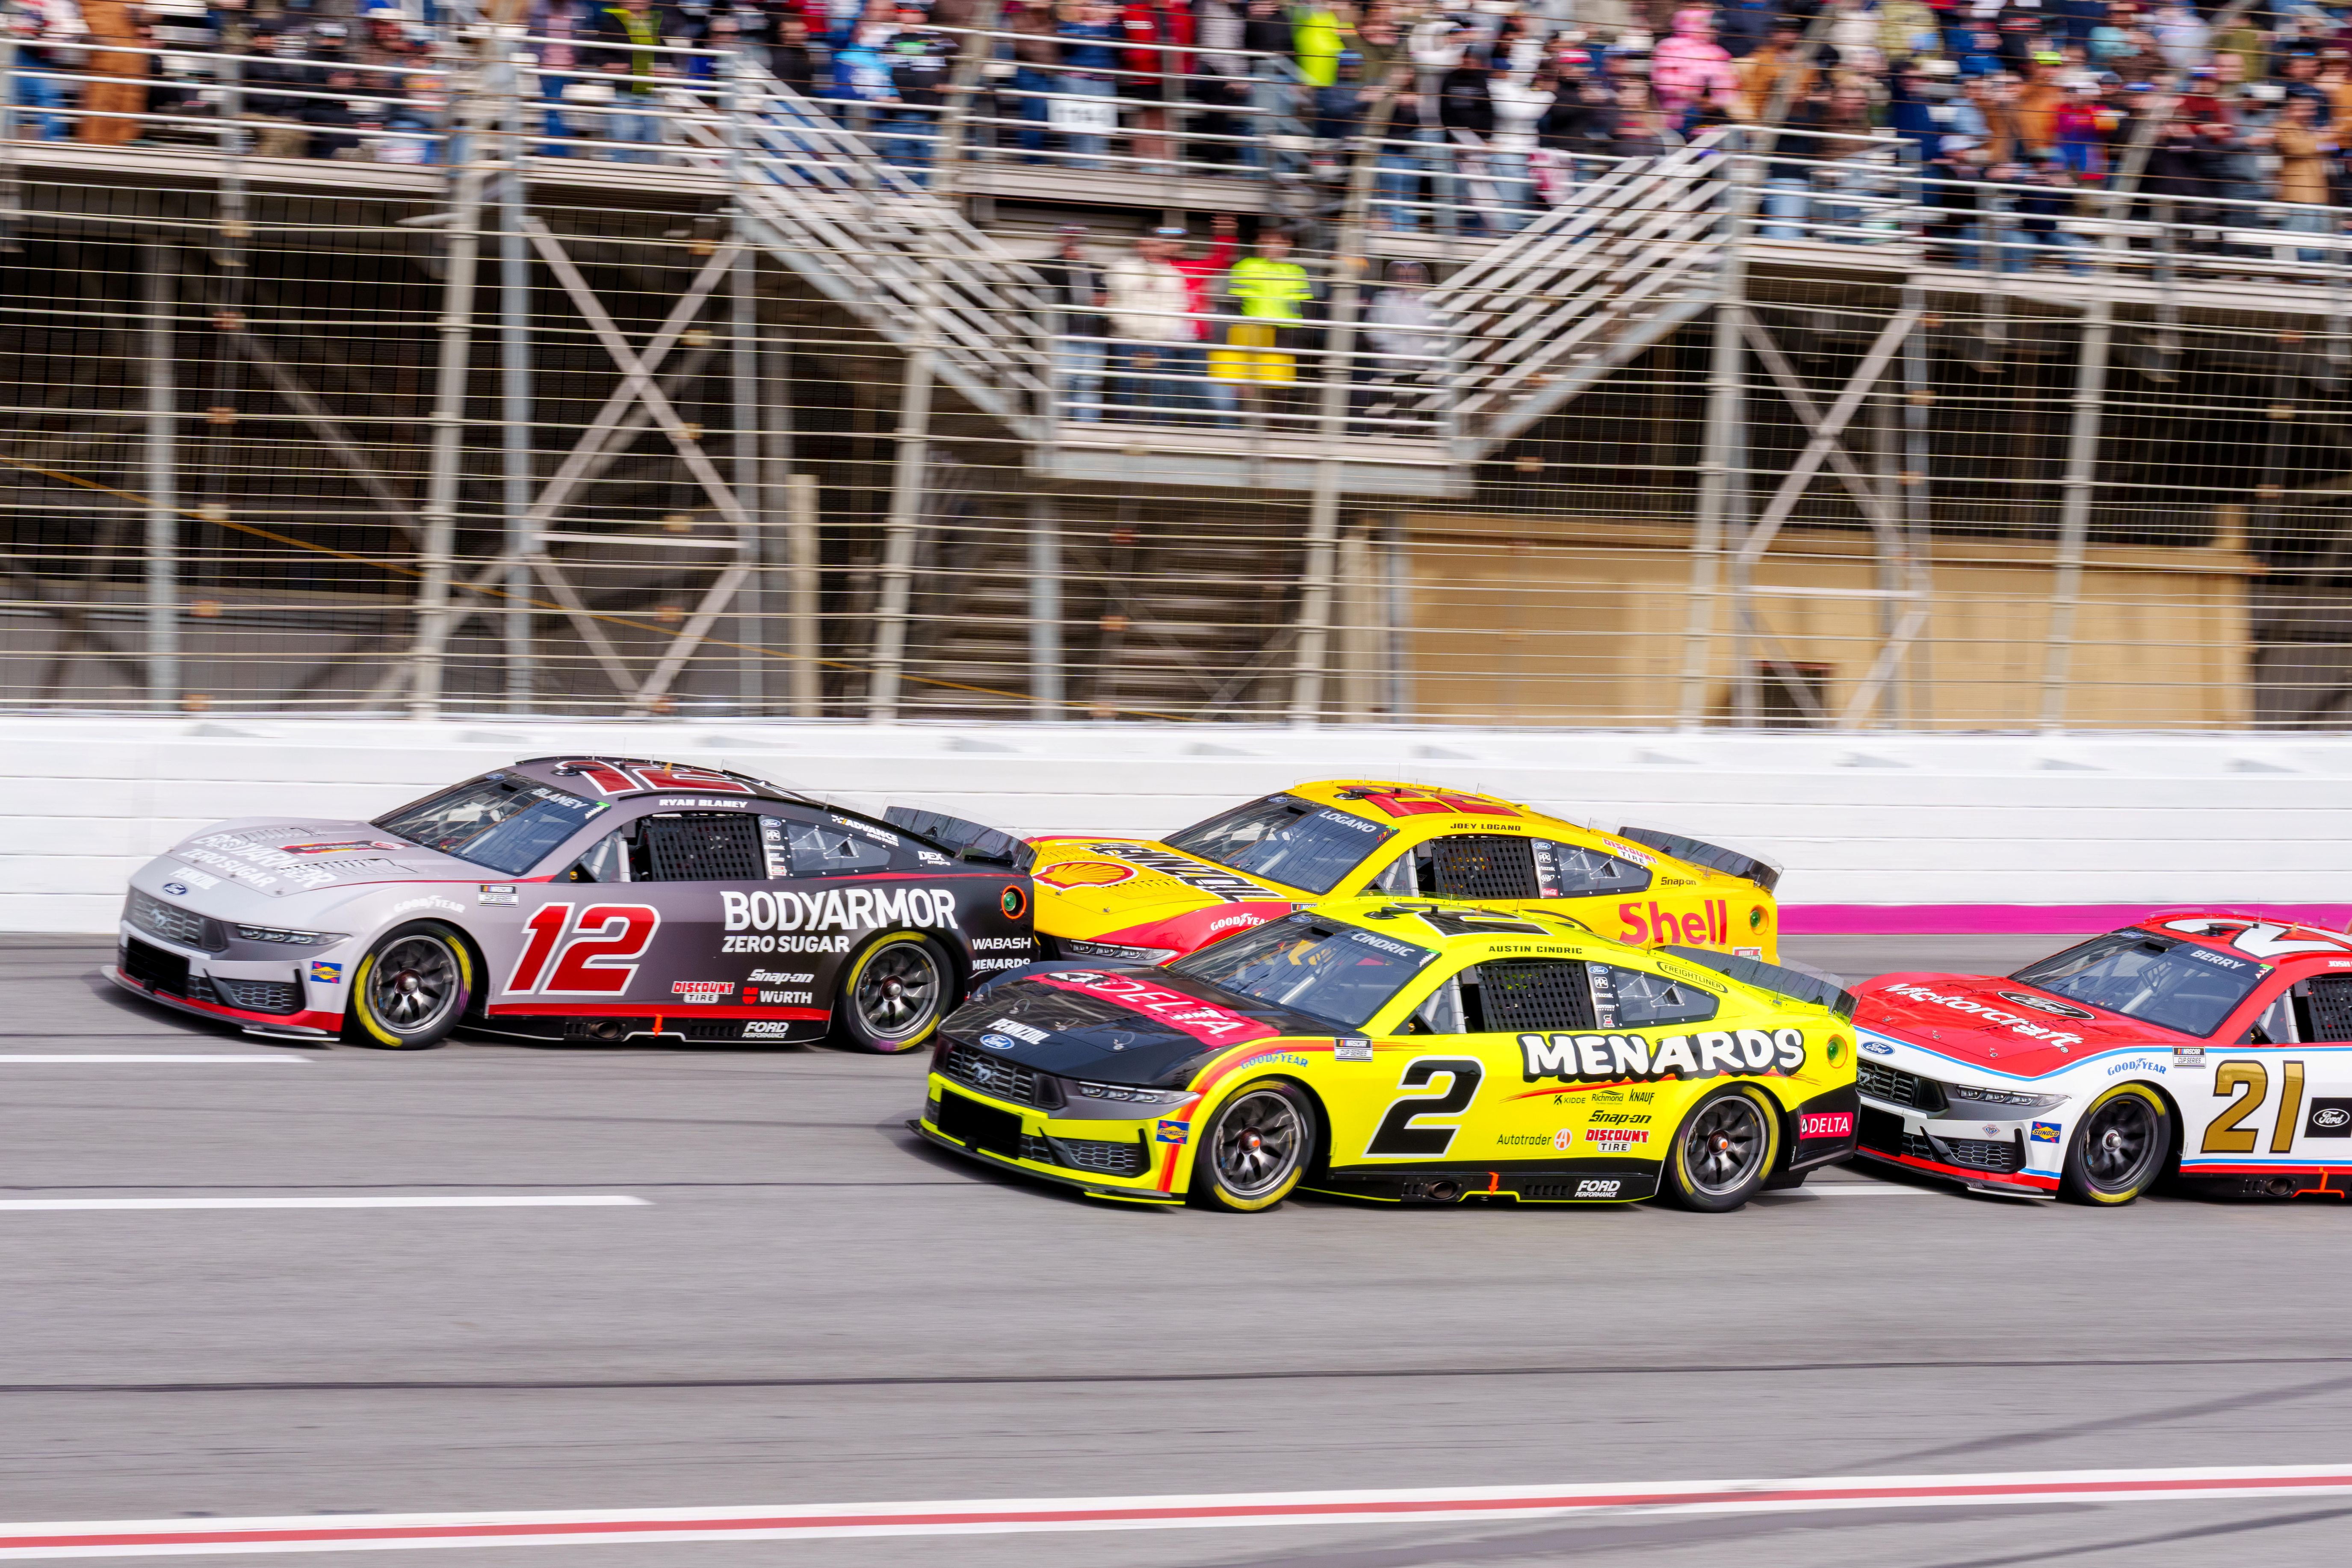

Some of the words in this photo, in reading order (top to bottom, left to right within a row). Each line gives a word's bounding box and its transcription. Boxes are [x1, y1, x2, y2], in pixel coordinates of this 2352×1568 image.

[532, 788, 589, 809] BLANEY
[698, 800, 748, 808] BLANEY
[845, 820, 898, 840] ADVANCE
[1318, 810, 1377, 833] LOGANO
[917, 851, 945, 861] DEX
[1602, 838, 1658, 864] DISCOUNT
[1622, 851, 1644, 864] TIRE
[216, 860, 278, 887] SUGAR
[1661, 877, 1696, 886] Snap-on
[720, 889, 958, 930] BODYARMOR
[1619, 900, 1727, 945] Shell
[501, 902, 661, 996] 12
[722, 936, 777, 953] ZERO
[778, 936, 850, 953] SUGAR
[972, 938, 1031, 950] WABASH
[1351, 933, 1415, 957] CINDRIC
[1536, 946, 1583, 954] CINDRIC
[2190, 949, 2246, 969] BERRY
[747, 969, 815, 985] Snap-on
[1665, 965, 1721, 989] FREIGHTLINER
[671, 981, 735, 994] DISCOUNT
[760, 991, 813, 1004] WÜRTH
[1884, 983, 2085, 1048] Motorcraft
[744, 1022, 789, 1033] FORD
[986, 1018, 1051, 1045] PENNZOIL
[1241, 1050, 1309, 1069] GOODYEAR
[1519, 1029, 1804, 1078] MENARDS
[2107, 1058, 2166, 1076] GOODYEAR
[1592, 1093, 1623, 1102] Richmond
[1629, 1089, 1655, 1105] KNAUF
[1361, 1055, 1486, 1158] 2
[2200, 1060, 2305, 1154] 21
[1588, 1110, 1652, 1125] Snap-on
[1809, 1117, 1849, 1133] DELTA
[1497, 1134, 1552, 1145] Autotrader
[1585, 1129, 1649, 1143] DISCOUNT
[1601, 1143, 1628, 1151] TIRE
[1577, 1180, 1620, 1191] FORD
